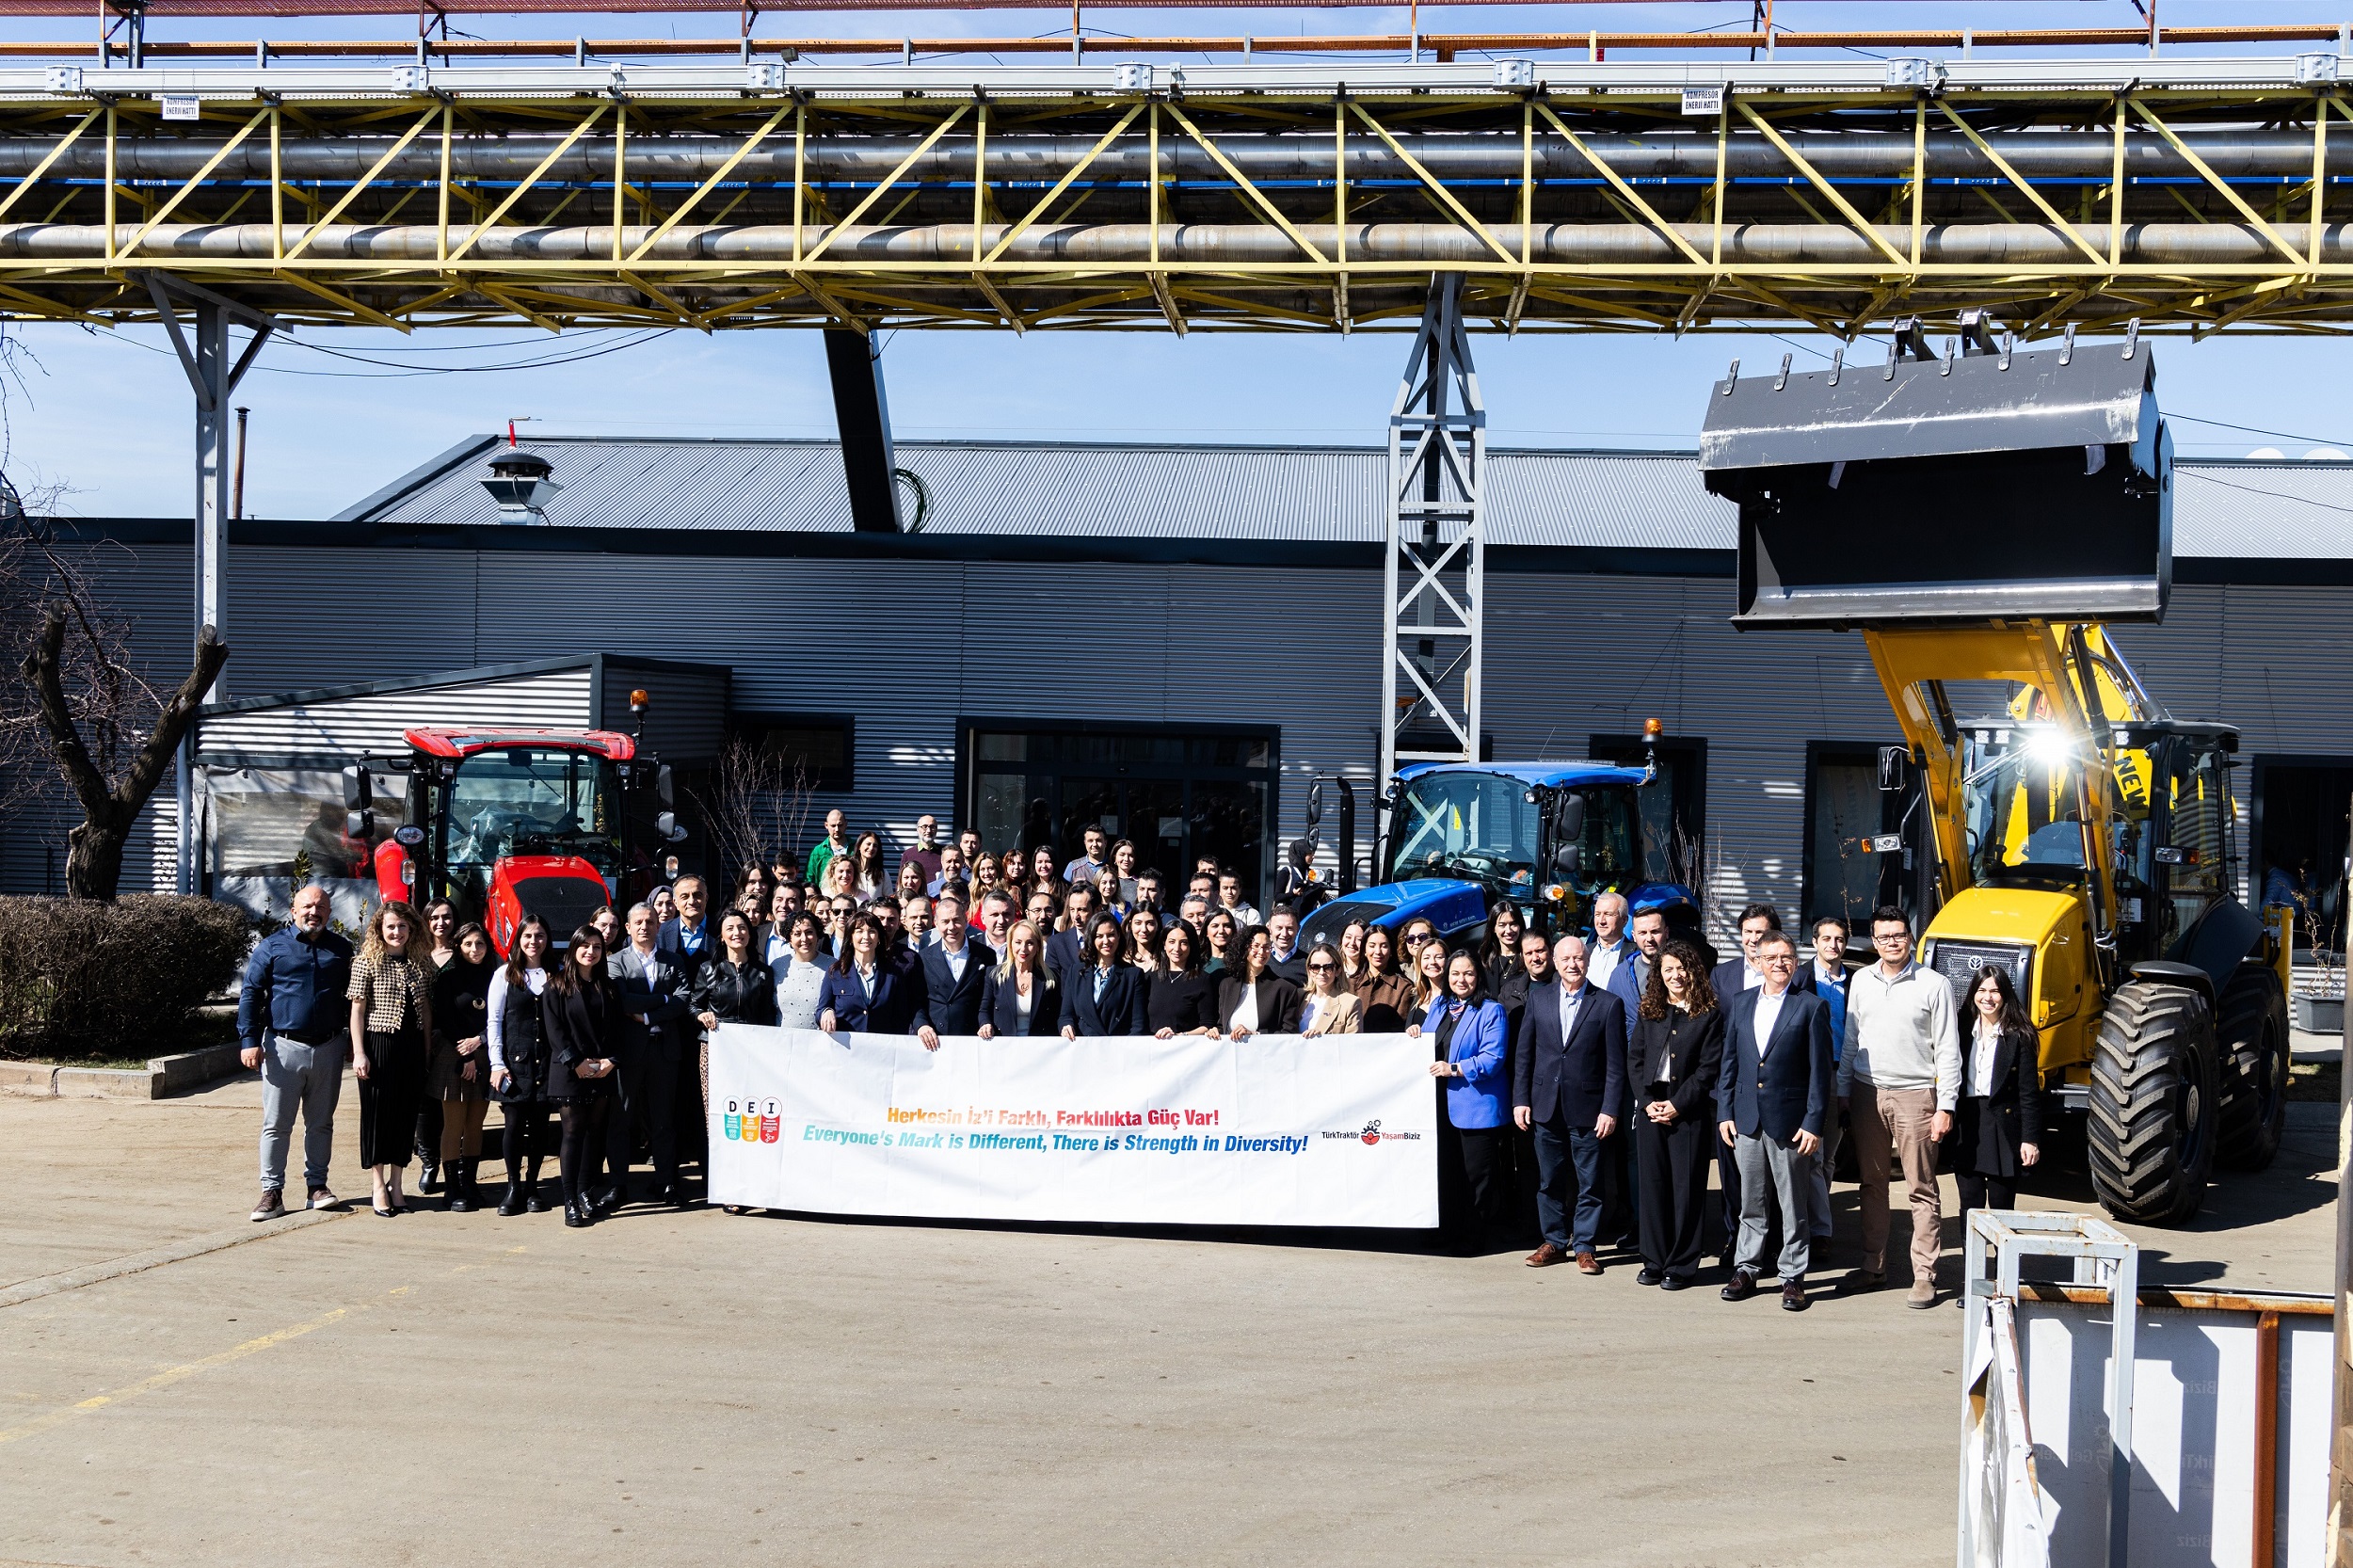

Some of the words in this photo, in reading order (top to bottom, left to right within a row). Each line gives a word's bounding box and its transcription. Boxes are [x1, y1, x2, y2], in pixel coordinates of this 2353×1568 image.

[182, 106, 196, 115] HATTI
[1704, 100, 1719, 109] HATTI
[2114, 756, 2149, 810] NEW
[888, 1107, 962, 1125] Herkesin
[999, 1110, 1051, 1128] Farklı,
[1057, 1111, 1143, 1127] Farklılıkta
[1148, 1109, 1180, 1129] Güç
[1184, 1109, 1219, 1127] Var!
[803, 1124, 893, 1147] Everyone's
[899, 1132, 943, 1148] Mark
[948, 1132, 964, 1149] is
[968, 1133, 1048, 1153] Different,
[1052, 1133, 1098, 1151] There
[1104, 1135, 1119, 1151] is
[1124, 1134, 1198, 1155] Strength
[1203, 1135, 1220, 1152] in
[1224, 1135, 1309, 1156] Diversity!
[1321, 1131, 1360, 1140] TürkTraktör
